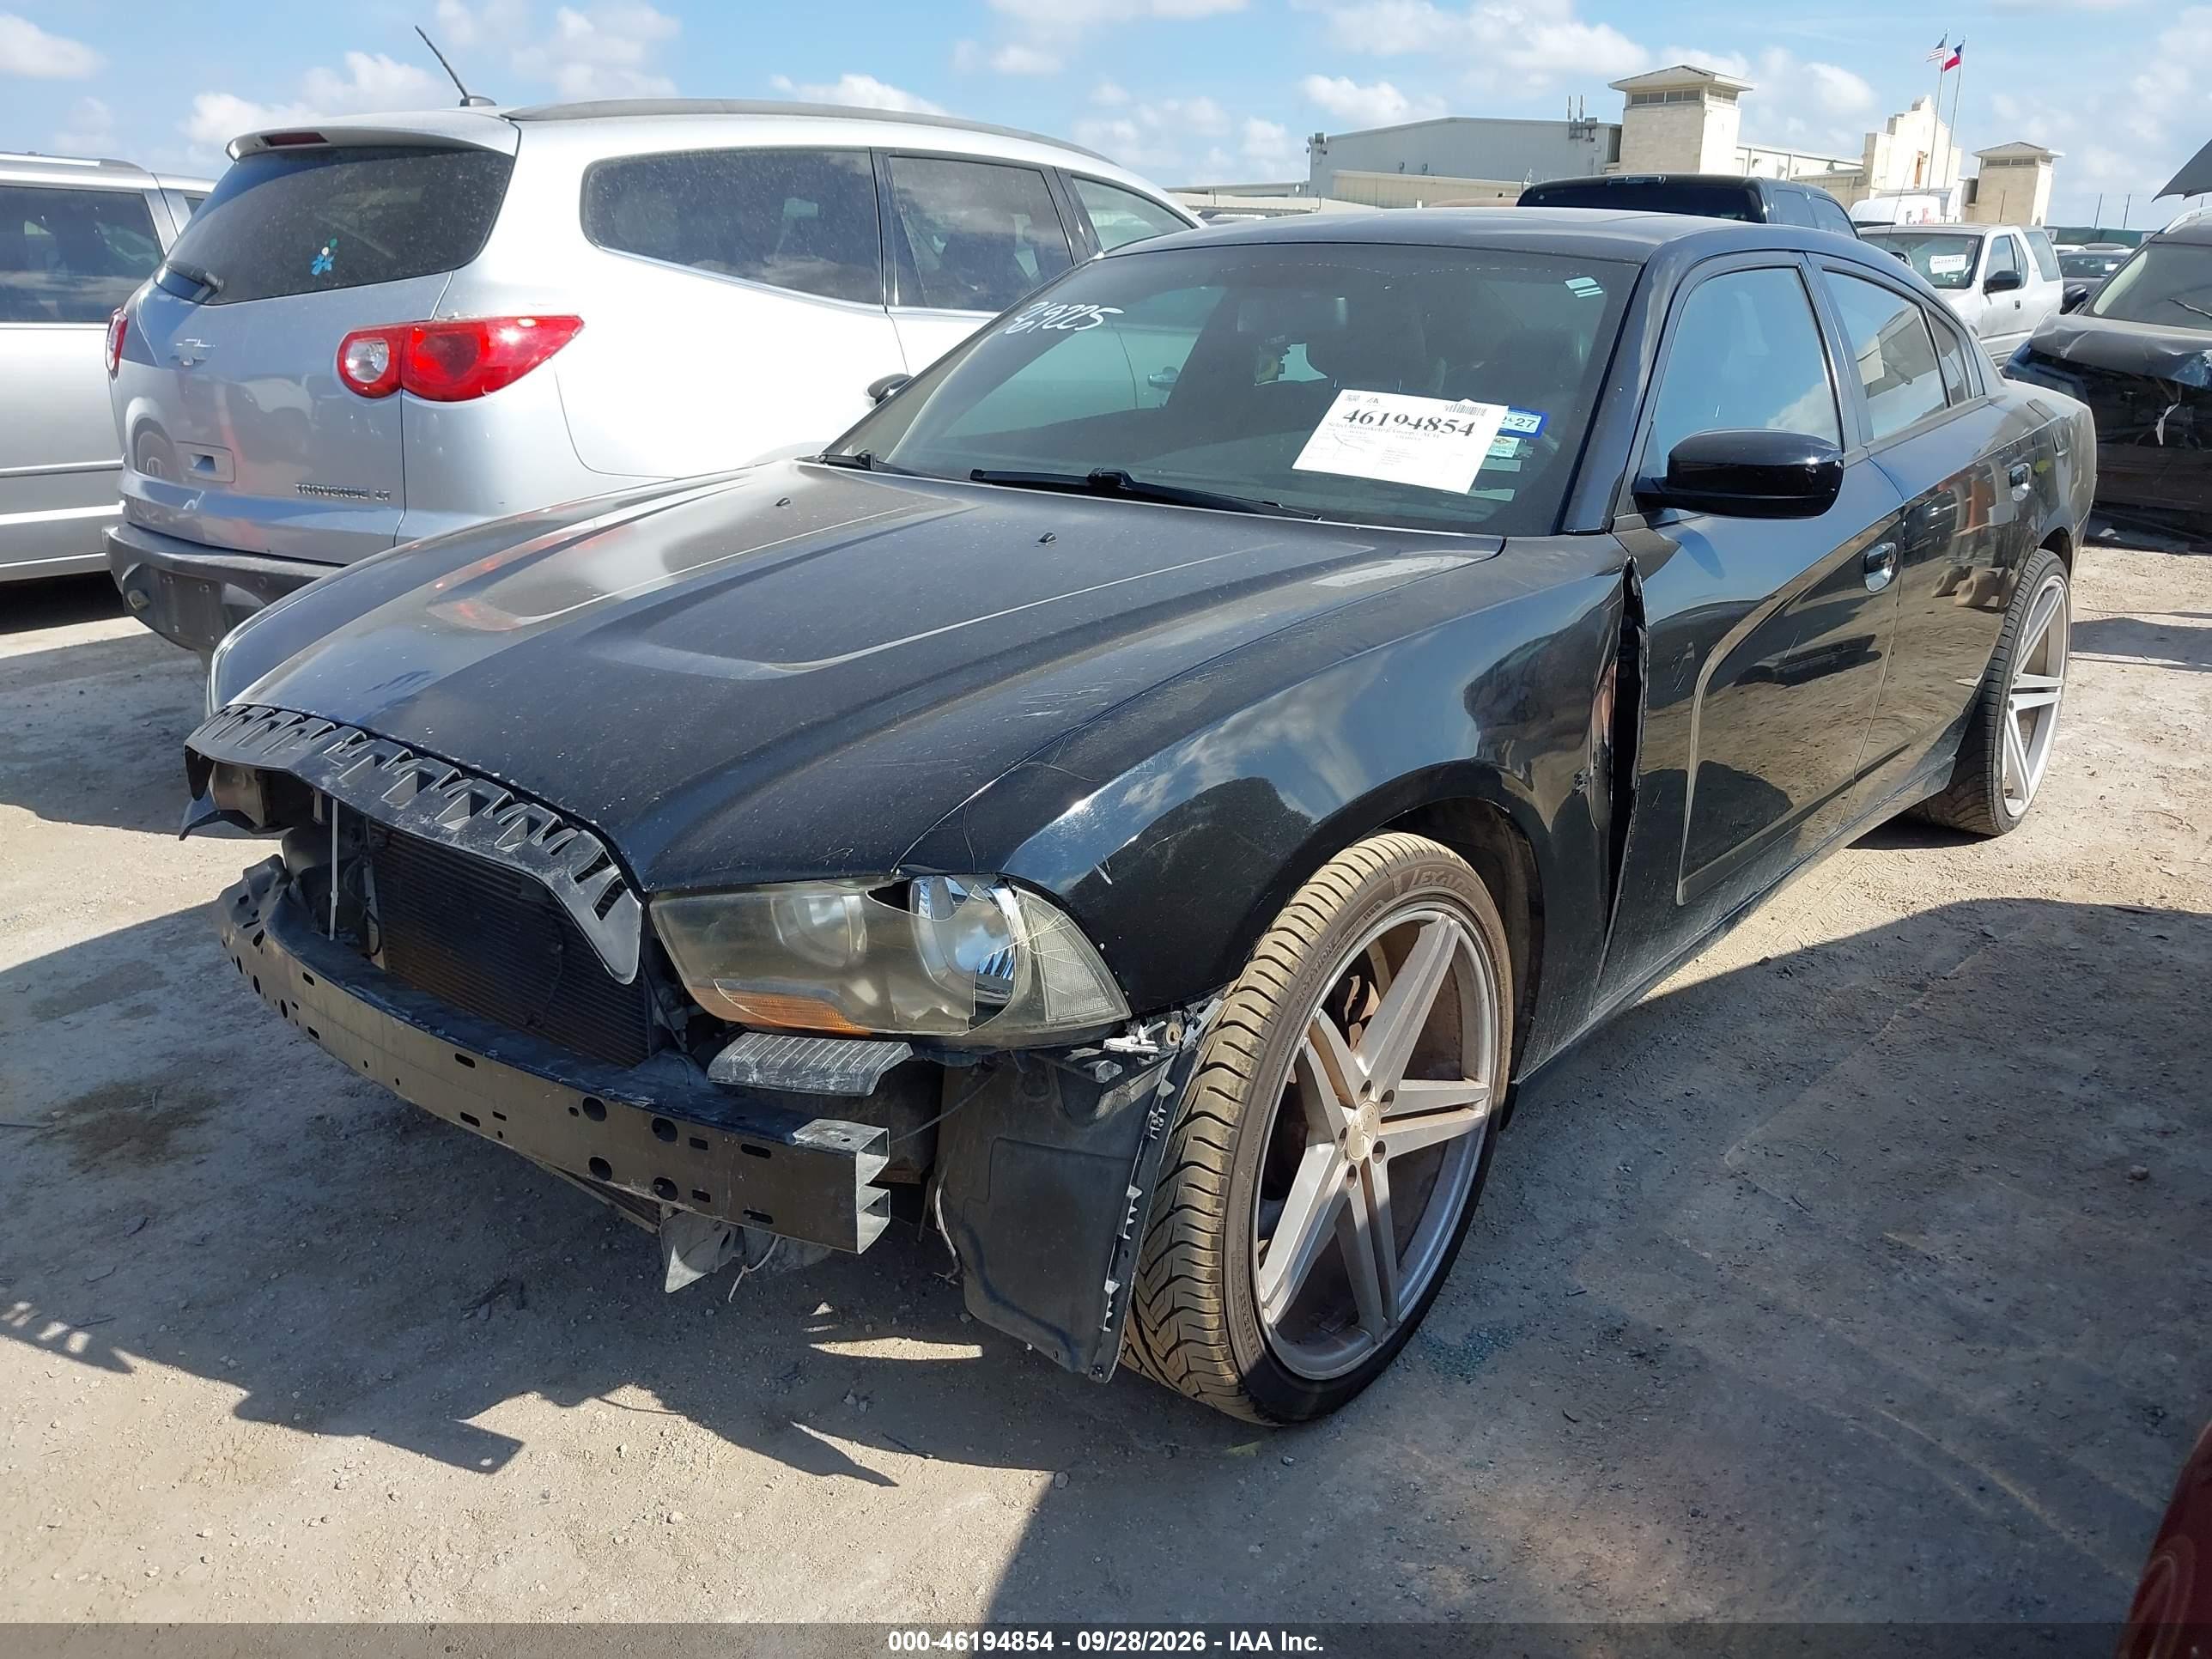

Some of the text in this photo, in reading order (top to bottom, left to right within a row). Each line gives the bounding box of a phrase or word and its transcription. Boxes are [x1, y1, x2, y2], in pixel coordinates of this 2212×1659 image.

[1342, 409, 1476, 437] 46194854
[295, 482, 392, 501] TRAVERSE LT
